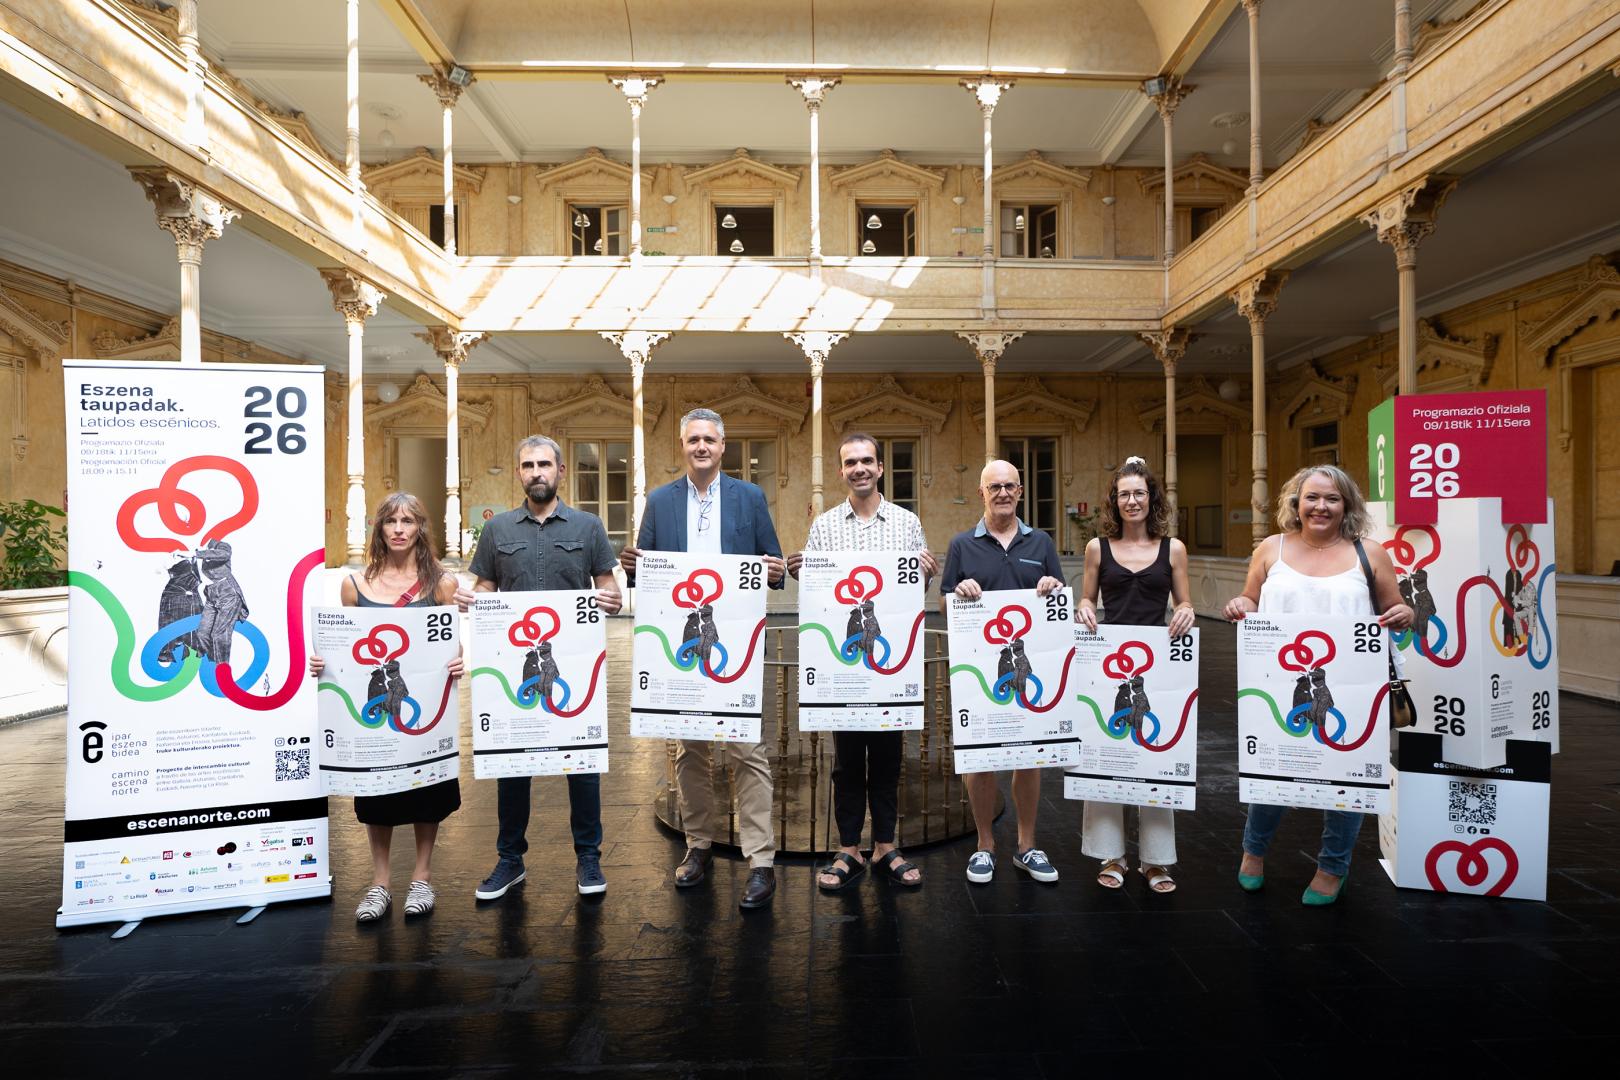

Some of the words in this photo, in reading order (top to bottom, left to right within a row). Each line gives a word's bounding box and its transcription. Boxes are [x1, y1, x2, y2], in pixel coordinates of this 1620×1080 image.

[80, 384, 154, 396] Eszena
[80, 398, 184, 414] taupadak.
[244, 385, 307, 418] 20
[1412, 407, 1484, 419] Programazio
[1487, 404, 1530, 415] Ofiziala
[80, 416, 136, 428] Latidos
[140, 417, 221, 429] escénicos.
[1423, 420, 1472, 430] 09/18tik
[1476, 418, 1530, 429] 11/15era
[244, 422, 307, 455] 26
[1409, 442, 1460, 470] 20
[1409, 470, 1460, 498] 26
[740, 562, 762, 576] 20
[898, 557, 920, 570] 20
[738, 576, 762, 590] 26
[898, 571, 920, 584] 26
[576, 596, 599, 610] 20
[1046, 594, 1068, 607] 20
[427, 613, 453, 627] 20
[576, 610, 600, 624] 26
[1046, 608, 1068, 621] 26
[427, 628, 453, 642] 26
[1354, 622, 1382, 637] 20
[1170, 634, 1193, 648] 20
[1354, 638, 1382, 653] 26
[1170, 648, 1193, 662] 26
[1434, 695, 1466, 717] 20
[1532, 690, 1550, 710] 20
[1434, 715, 1466, 736] 26
[1532, 710, 1550, 730] 26
[112, 732, 131, 742] ipar
[112, 740, 147, 749] eszena
[112, 749, 140, 757] bidea
[112, 770, 149, 779] camino
[112, 779, 148, 787] escena
[112, 787, 140, 796] norte
[127, 806, 271, 831] escenanorte.com
